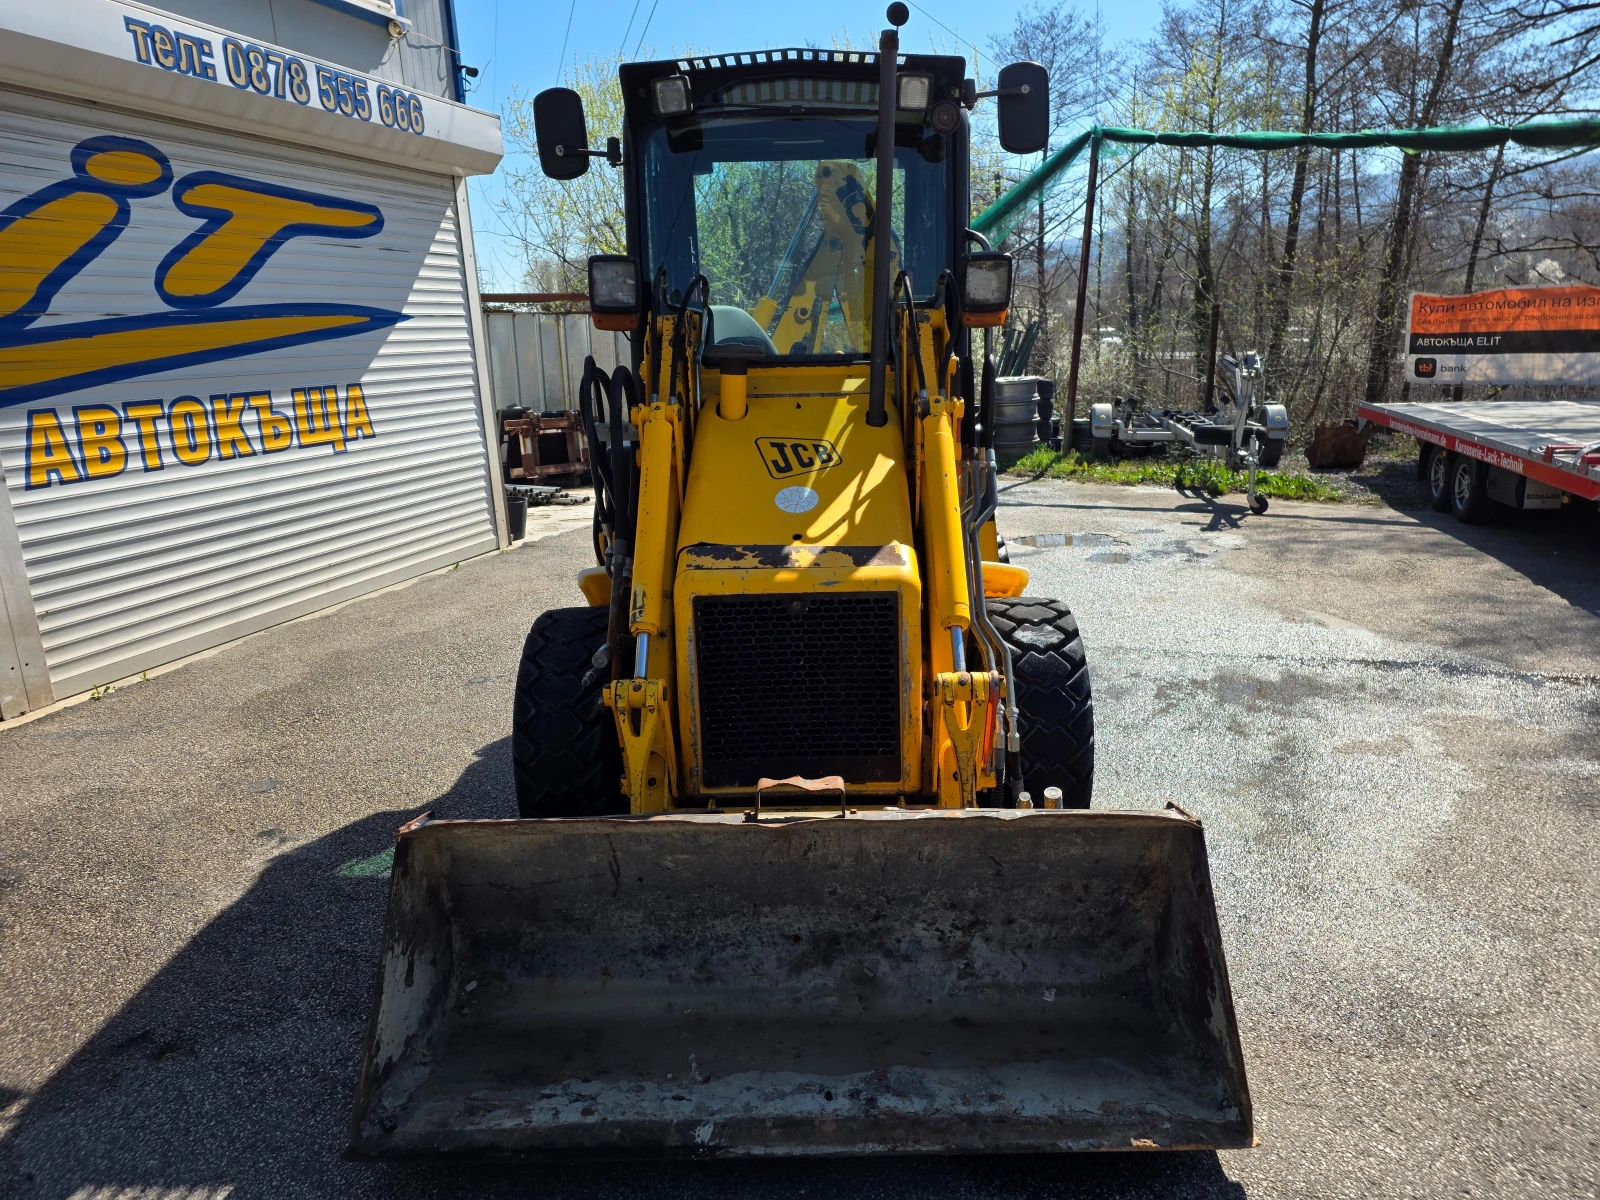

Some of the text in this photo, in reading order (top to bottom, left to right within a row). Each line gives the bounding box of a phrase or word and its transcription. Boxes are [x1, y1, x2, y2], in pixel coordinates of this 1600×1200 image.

[222, 36, 310, 105] 0878
[315, 65, 371, 121] 555
[376, 84, 425, 135] 666
[1419, 302, 1455, 316] Купи
[1459, 297, 1547, 312] автомобил
[1552, 297, 1571, 308] на
[1416, 336, 1502, 347] АВТОКЪЩА ELIT
[1418, 363, 1467, 373] tbi bank
[25, 383, 376, 491] АВТОКЪЩА
[769, 441, 834, 473] JCB
